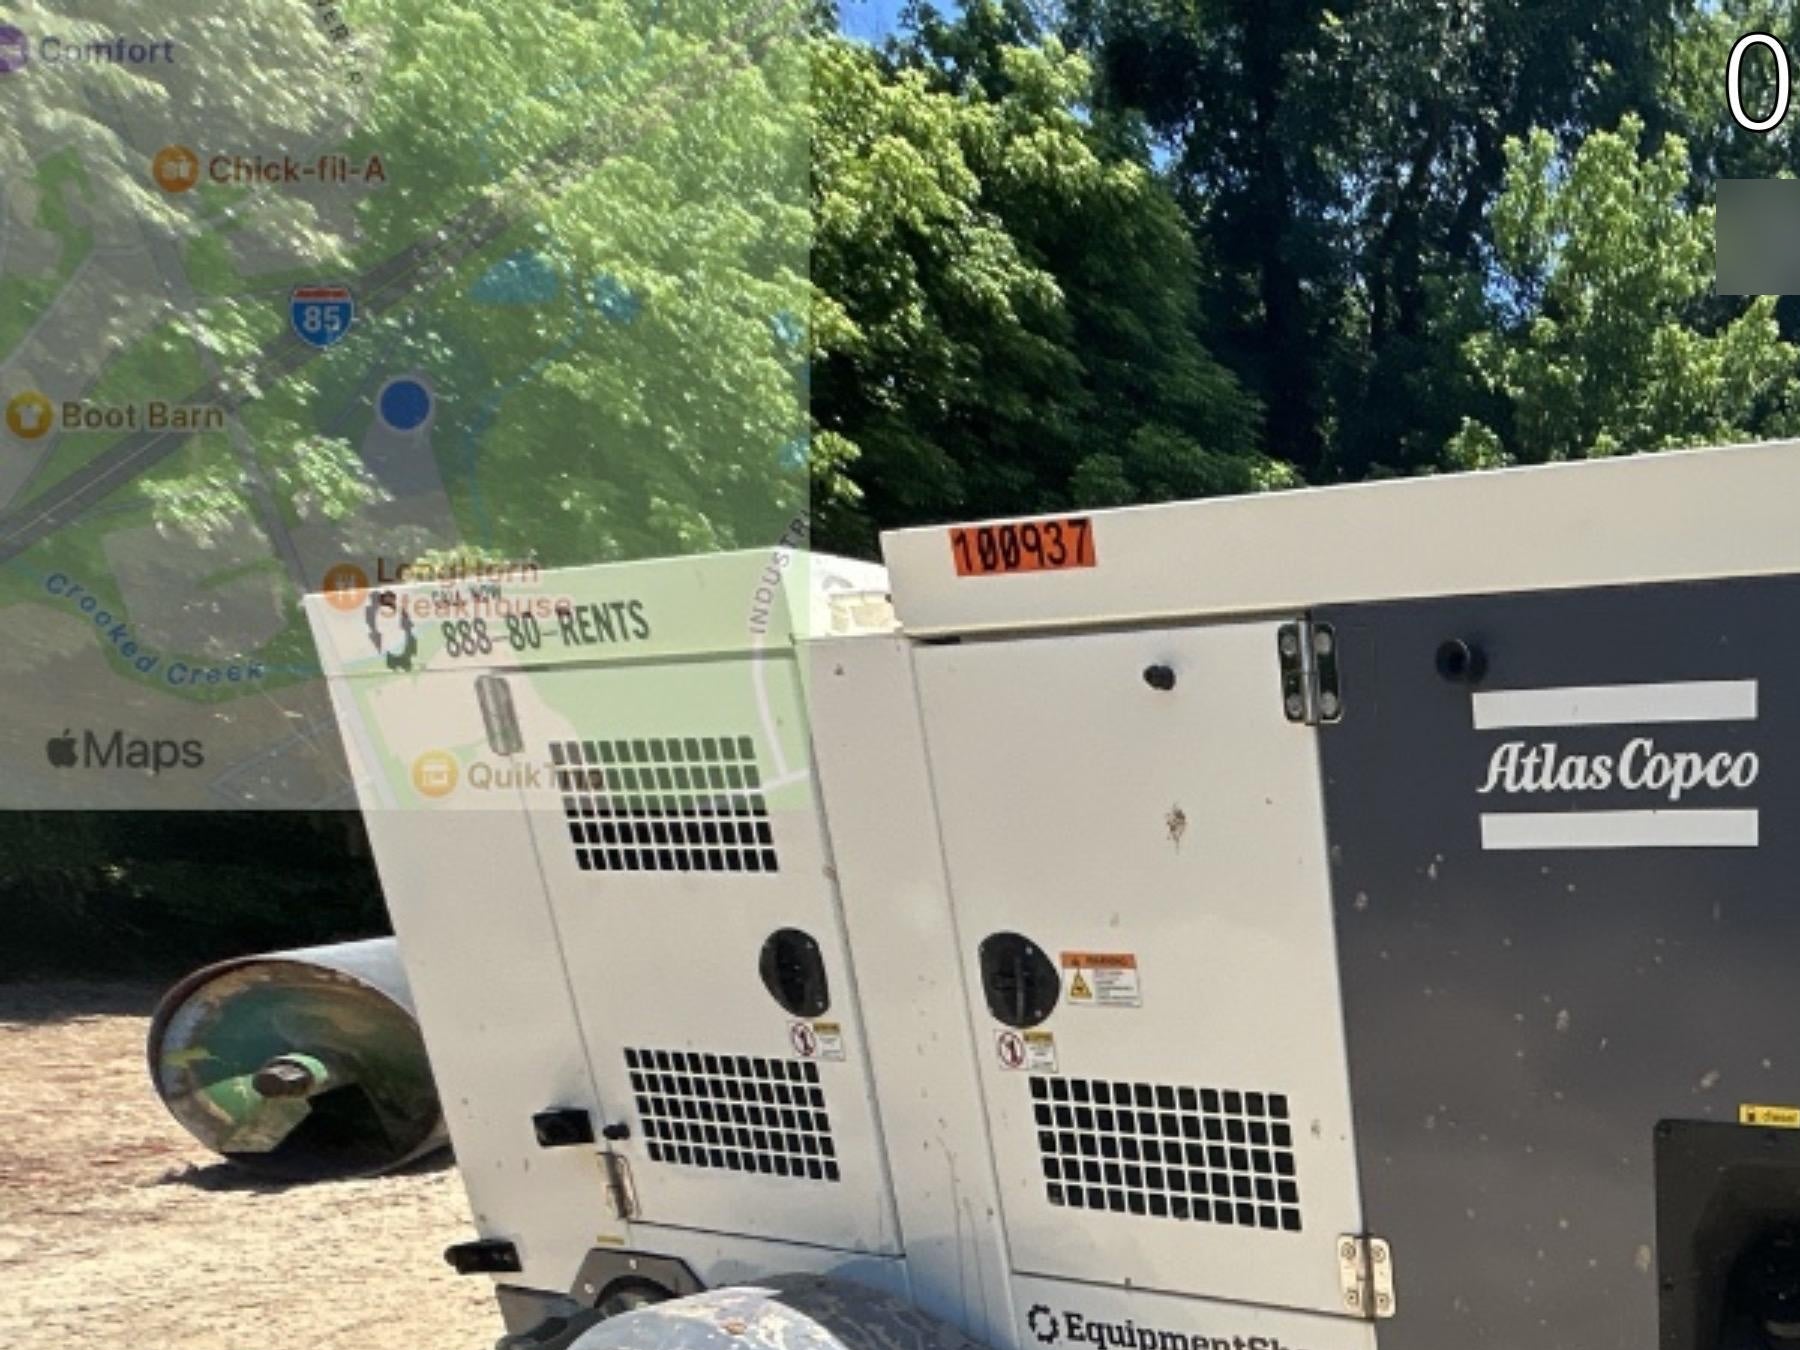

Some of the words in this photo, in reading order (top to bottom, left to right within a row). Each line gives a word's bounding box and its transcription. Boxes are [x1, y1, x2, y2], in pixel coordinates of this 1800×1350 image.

[951, 518, 1090, 572] 100937
[1476, 740, 1612, 793] Atlas
[1618, 737, 1760, 801] Copco
